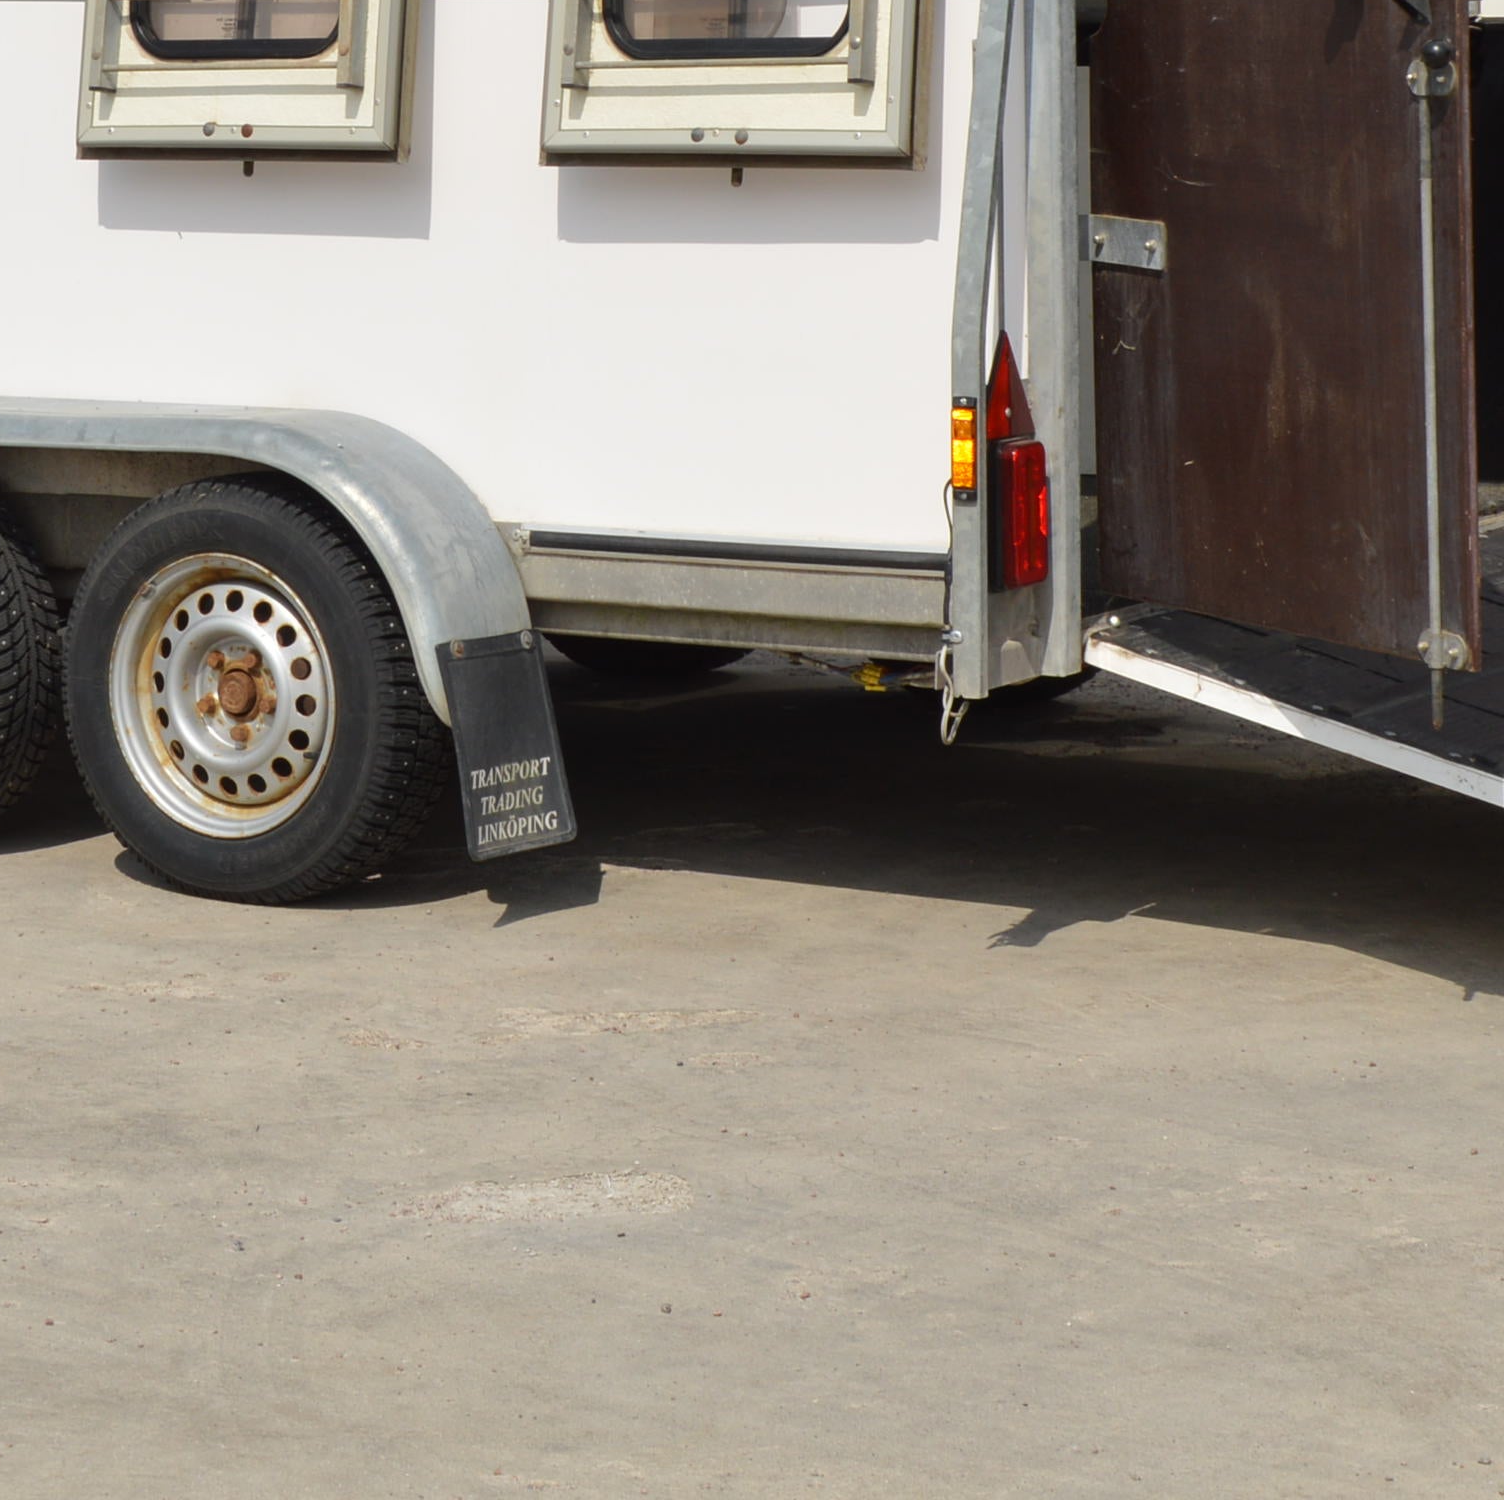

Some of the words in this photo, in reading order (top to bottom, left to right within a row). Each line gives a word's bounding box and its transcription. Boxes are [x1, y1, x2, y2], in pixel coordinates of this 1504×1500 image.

[470, 756, 551, 791] TRANSPORT
[480, 785, 544, 816] TRADING
[477, 810, 559, 846] LINKÖPING
